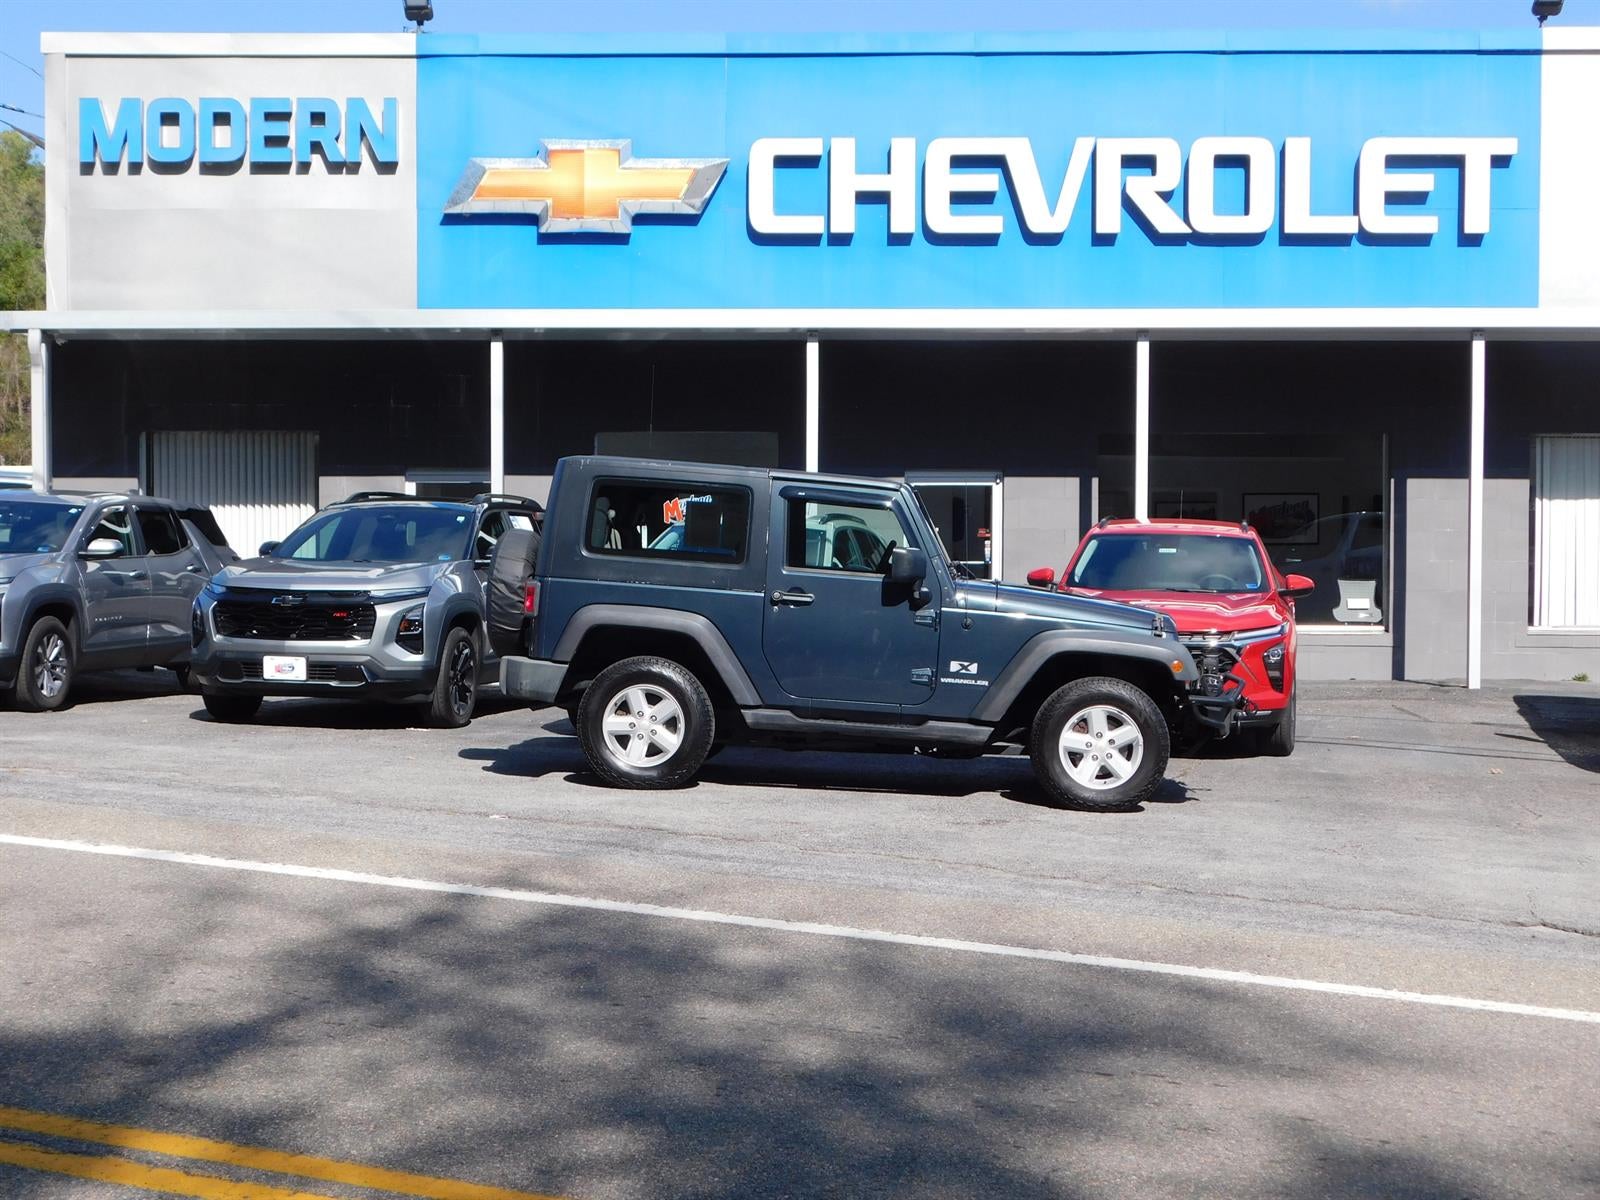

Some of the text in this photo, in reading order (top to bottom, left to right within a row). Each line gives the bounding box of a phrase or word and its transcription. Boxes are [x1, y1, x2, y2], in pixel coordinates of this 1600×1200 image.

[79, 97, 398, 164] MODERN
[747, 137, 1518, 236] CHEVROLET
[940, 677, 989, 687] WRANGLER
